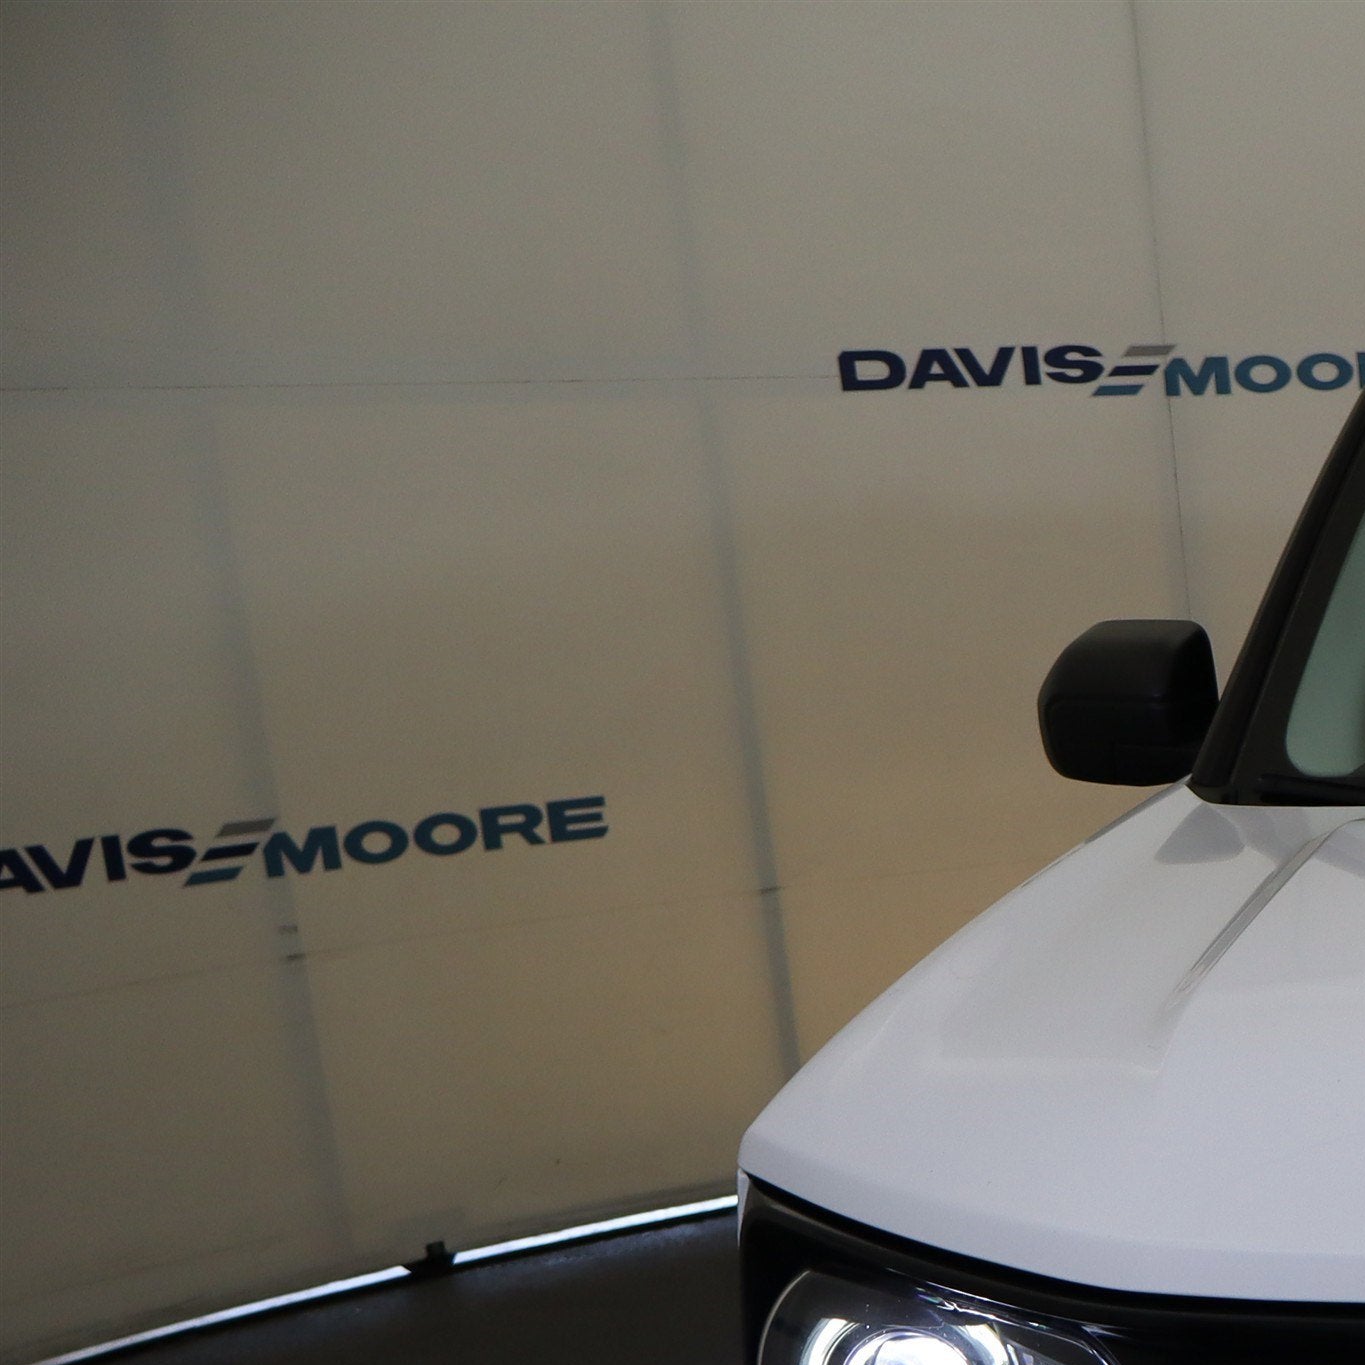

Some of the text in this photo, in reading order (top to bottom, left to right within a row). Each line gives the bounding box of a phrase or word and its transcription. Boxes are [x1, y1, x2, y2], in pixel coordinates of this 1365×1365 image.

[837, 344, 1105, 391] DAVIS
[0, 796, 609, 894] AVIS MOORE
